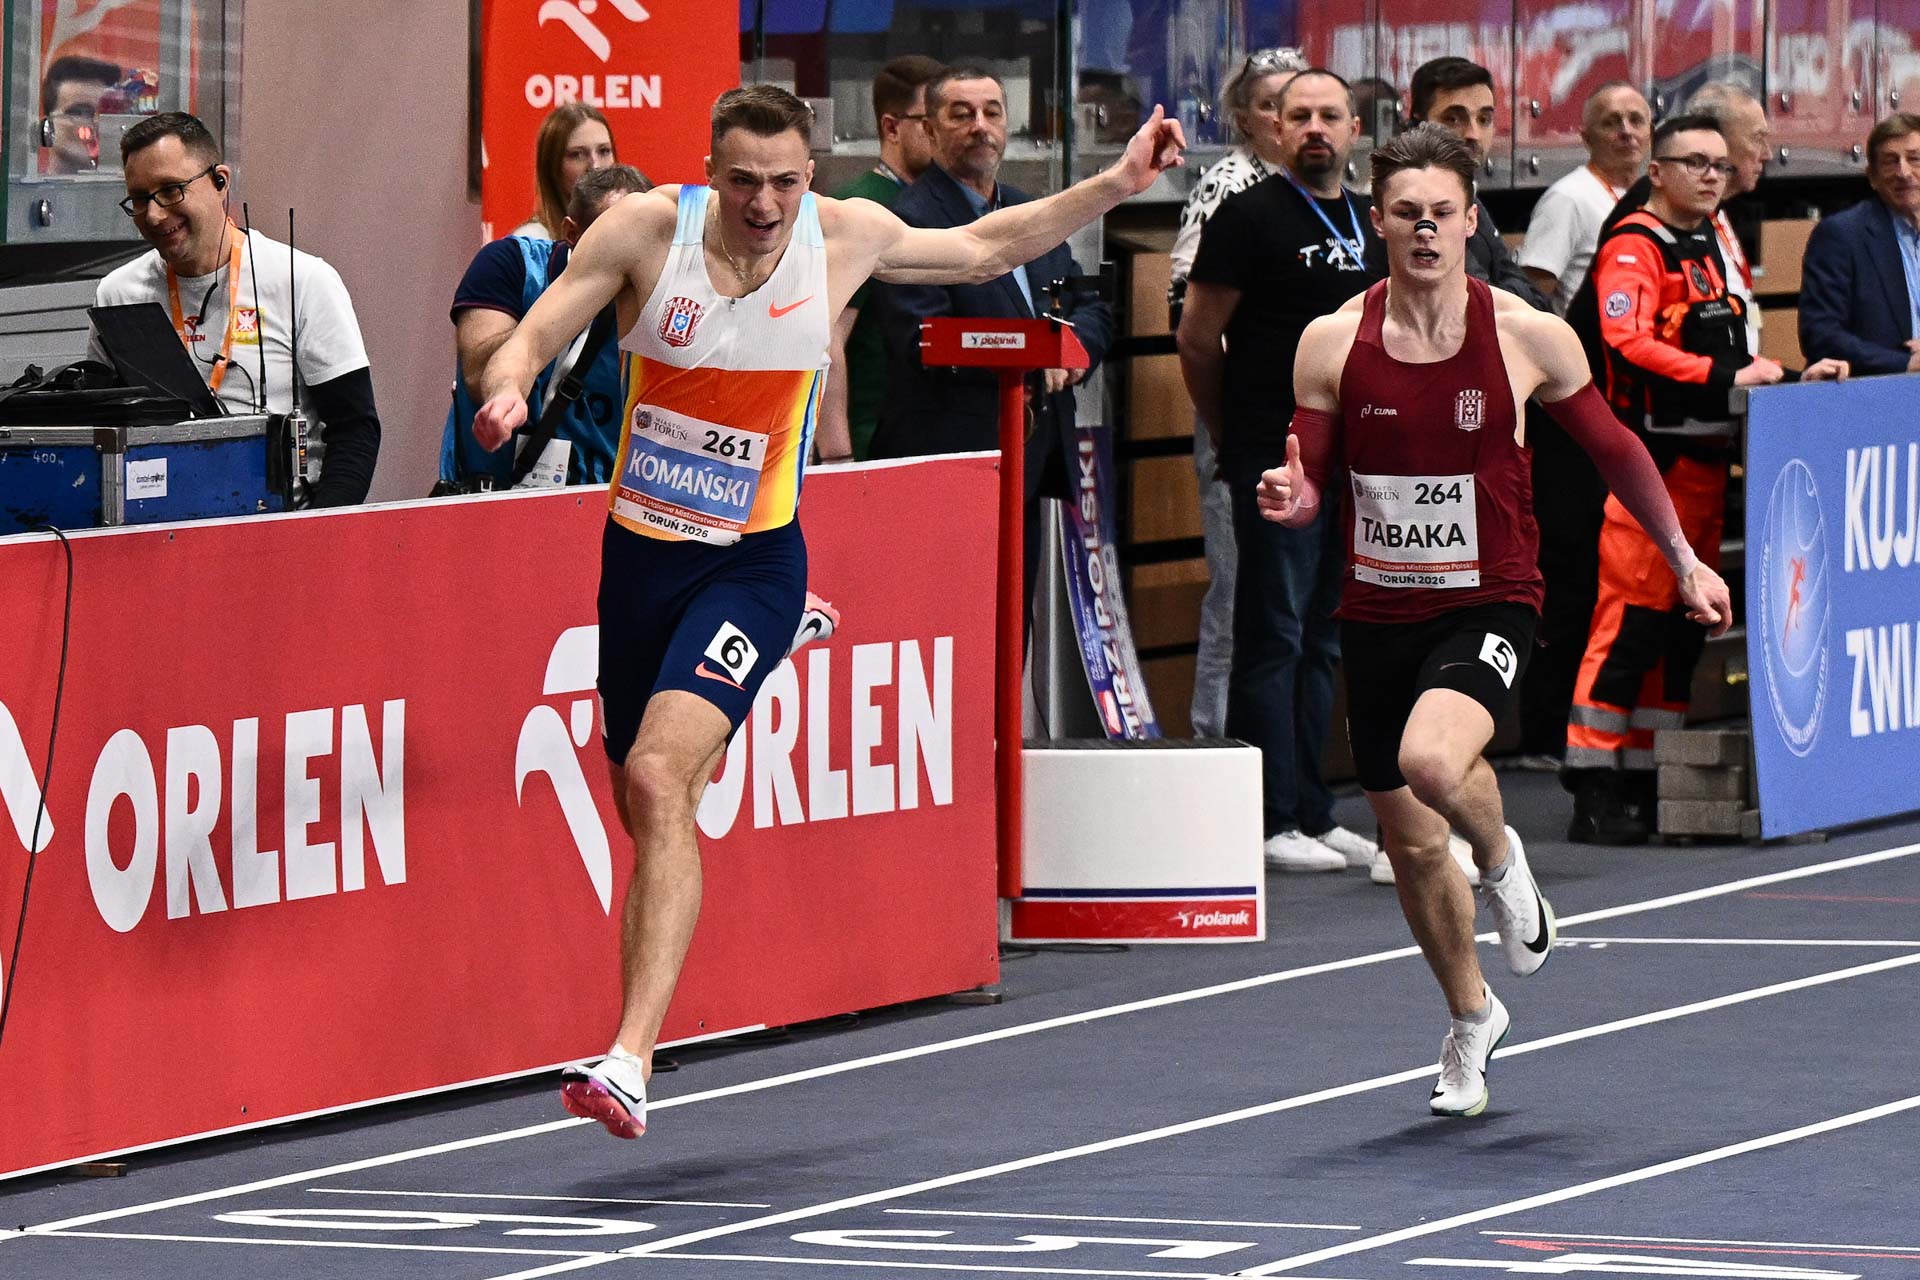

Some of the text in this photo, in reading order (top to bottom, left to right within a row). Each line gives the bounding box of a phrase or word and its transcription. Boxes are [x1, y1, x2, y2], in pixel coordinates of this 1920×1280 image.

[525, 74, 661, 108] ORLEN
[980, 335, 1018, 346] polanik
[1374, 408, 1397, 416] CUNA
[653, 422, 688, 441] TORUŃ
[701, 430, 752, 461] 261
[628, 448, 750, 508] KOMAŃSKI
[1414, 482, 1463, 505] 264
[1365, 489, 1400, 501] TORUŃ
[1845, 442, 1920, 573] KUJ
[643, 511, 709, 538] TORUŃ 2026
[648, 499, 674, 513] Halowe
[675, 507, 718, 527] Mistrzostwa
[718, 519, 740, 531] Polski
[1078, 439, 1113, 628] POLSKI
[1362, 517, 1467, 548] TABAKA
[1378, 573, 1446, 585] TORUŃ 2026
[1406, 563, 1451, 572] Mistrzostwa
[1451, 562, 1473, 570] Polski
[721, 635, 748, 669] 6
[1492, 641, 1513, 673] 5
[1102, 641, 1145, 740] TRZ
[1846, 621, 1920, 737] ZWI
[85, 698, 406, 932] ORLEN
[1193, 910, 1250, 929] polanik
